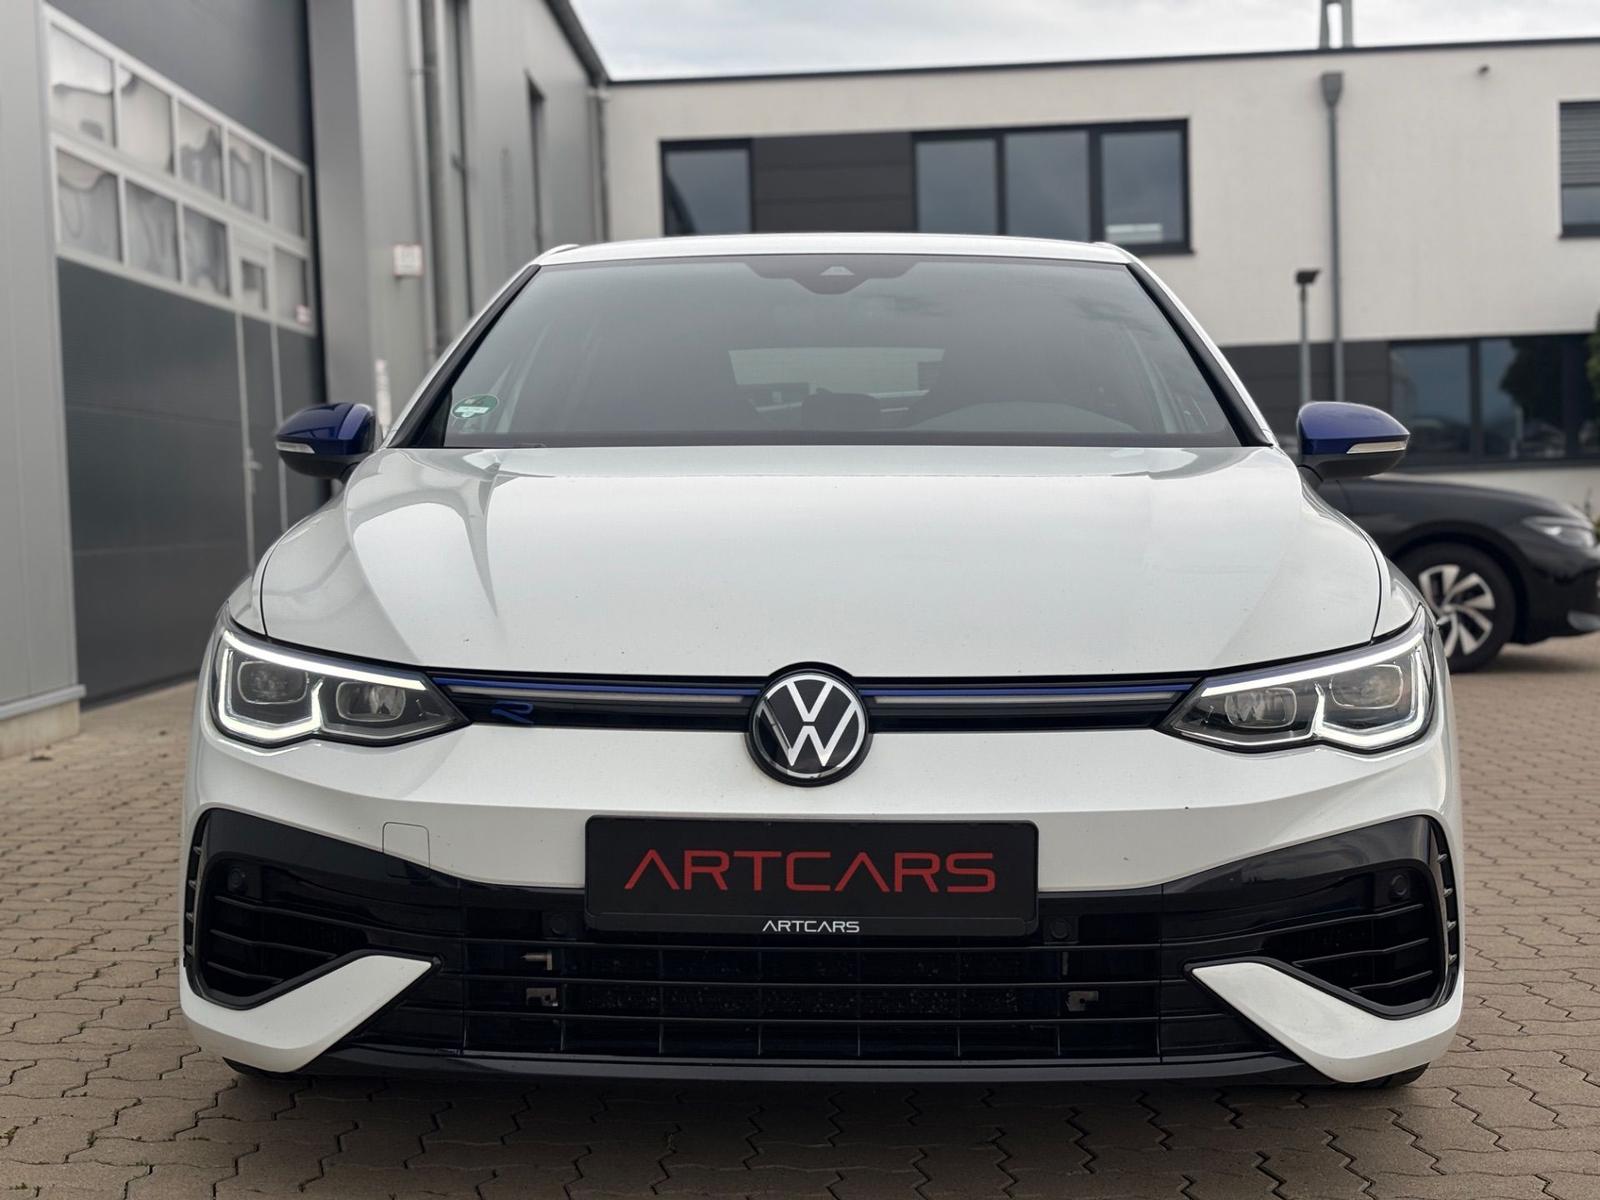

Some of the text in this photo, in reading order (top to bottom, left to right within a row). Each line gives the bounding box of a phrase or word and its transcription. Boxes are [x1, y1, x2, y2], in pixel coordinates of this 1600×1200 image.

[491, 700, 535, 724] R
[759, 679, 859, 767] VW
[624, 849, 996, 893] ARTCARS
[762, 919, 861, 934] ARTCARS
